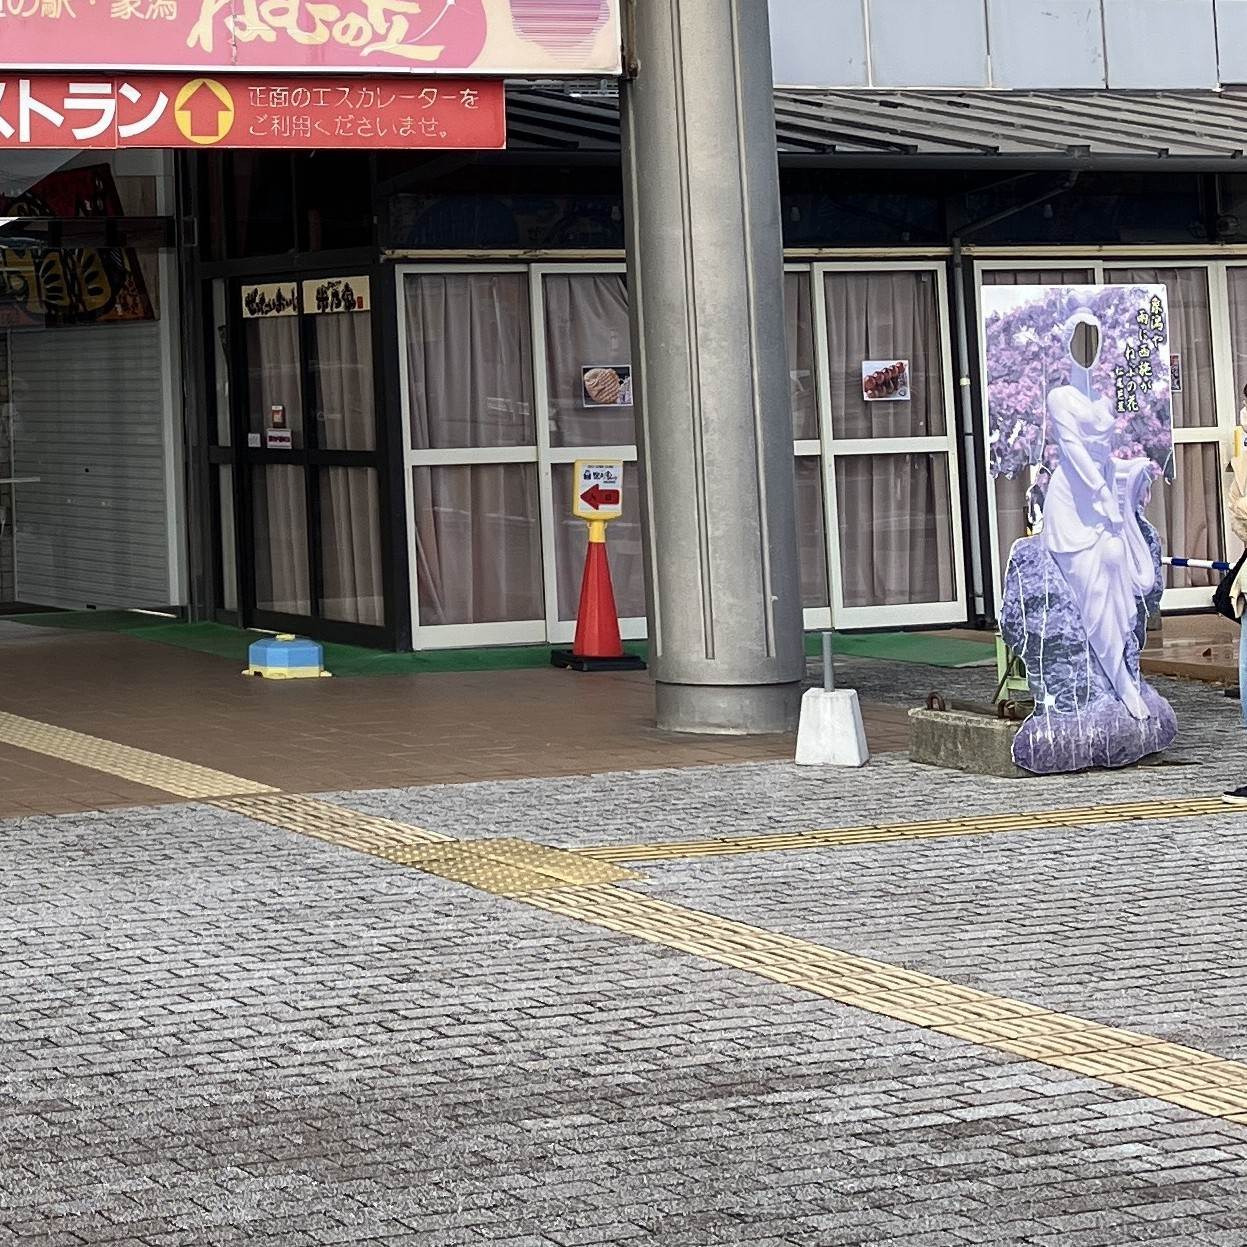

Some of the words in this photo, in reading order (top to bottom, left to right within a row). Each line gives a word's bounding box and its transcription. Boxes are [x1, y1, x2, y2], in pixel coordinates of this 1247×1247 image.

[248, 87, 479, 109] 正面のエスカレーターを
[249, 114, 448, 138] ご利用くださいませ。
